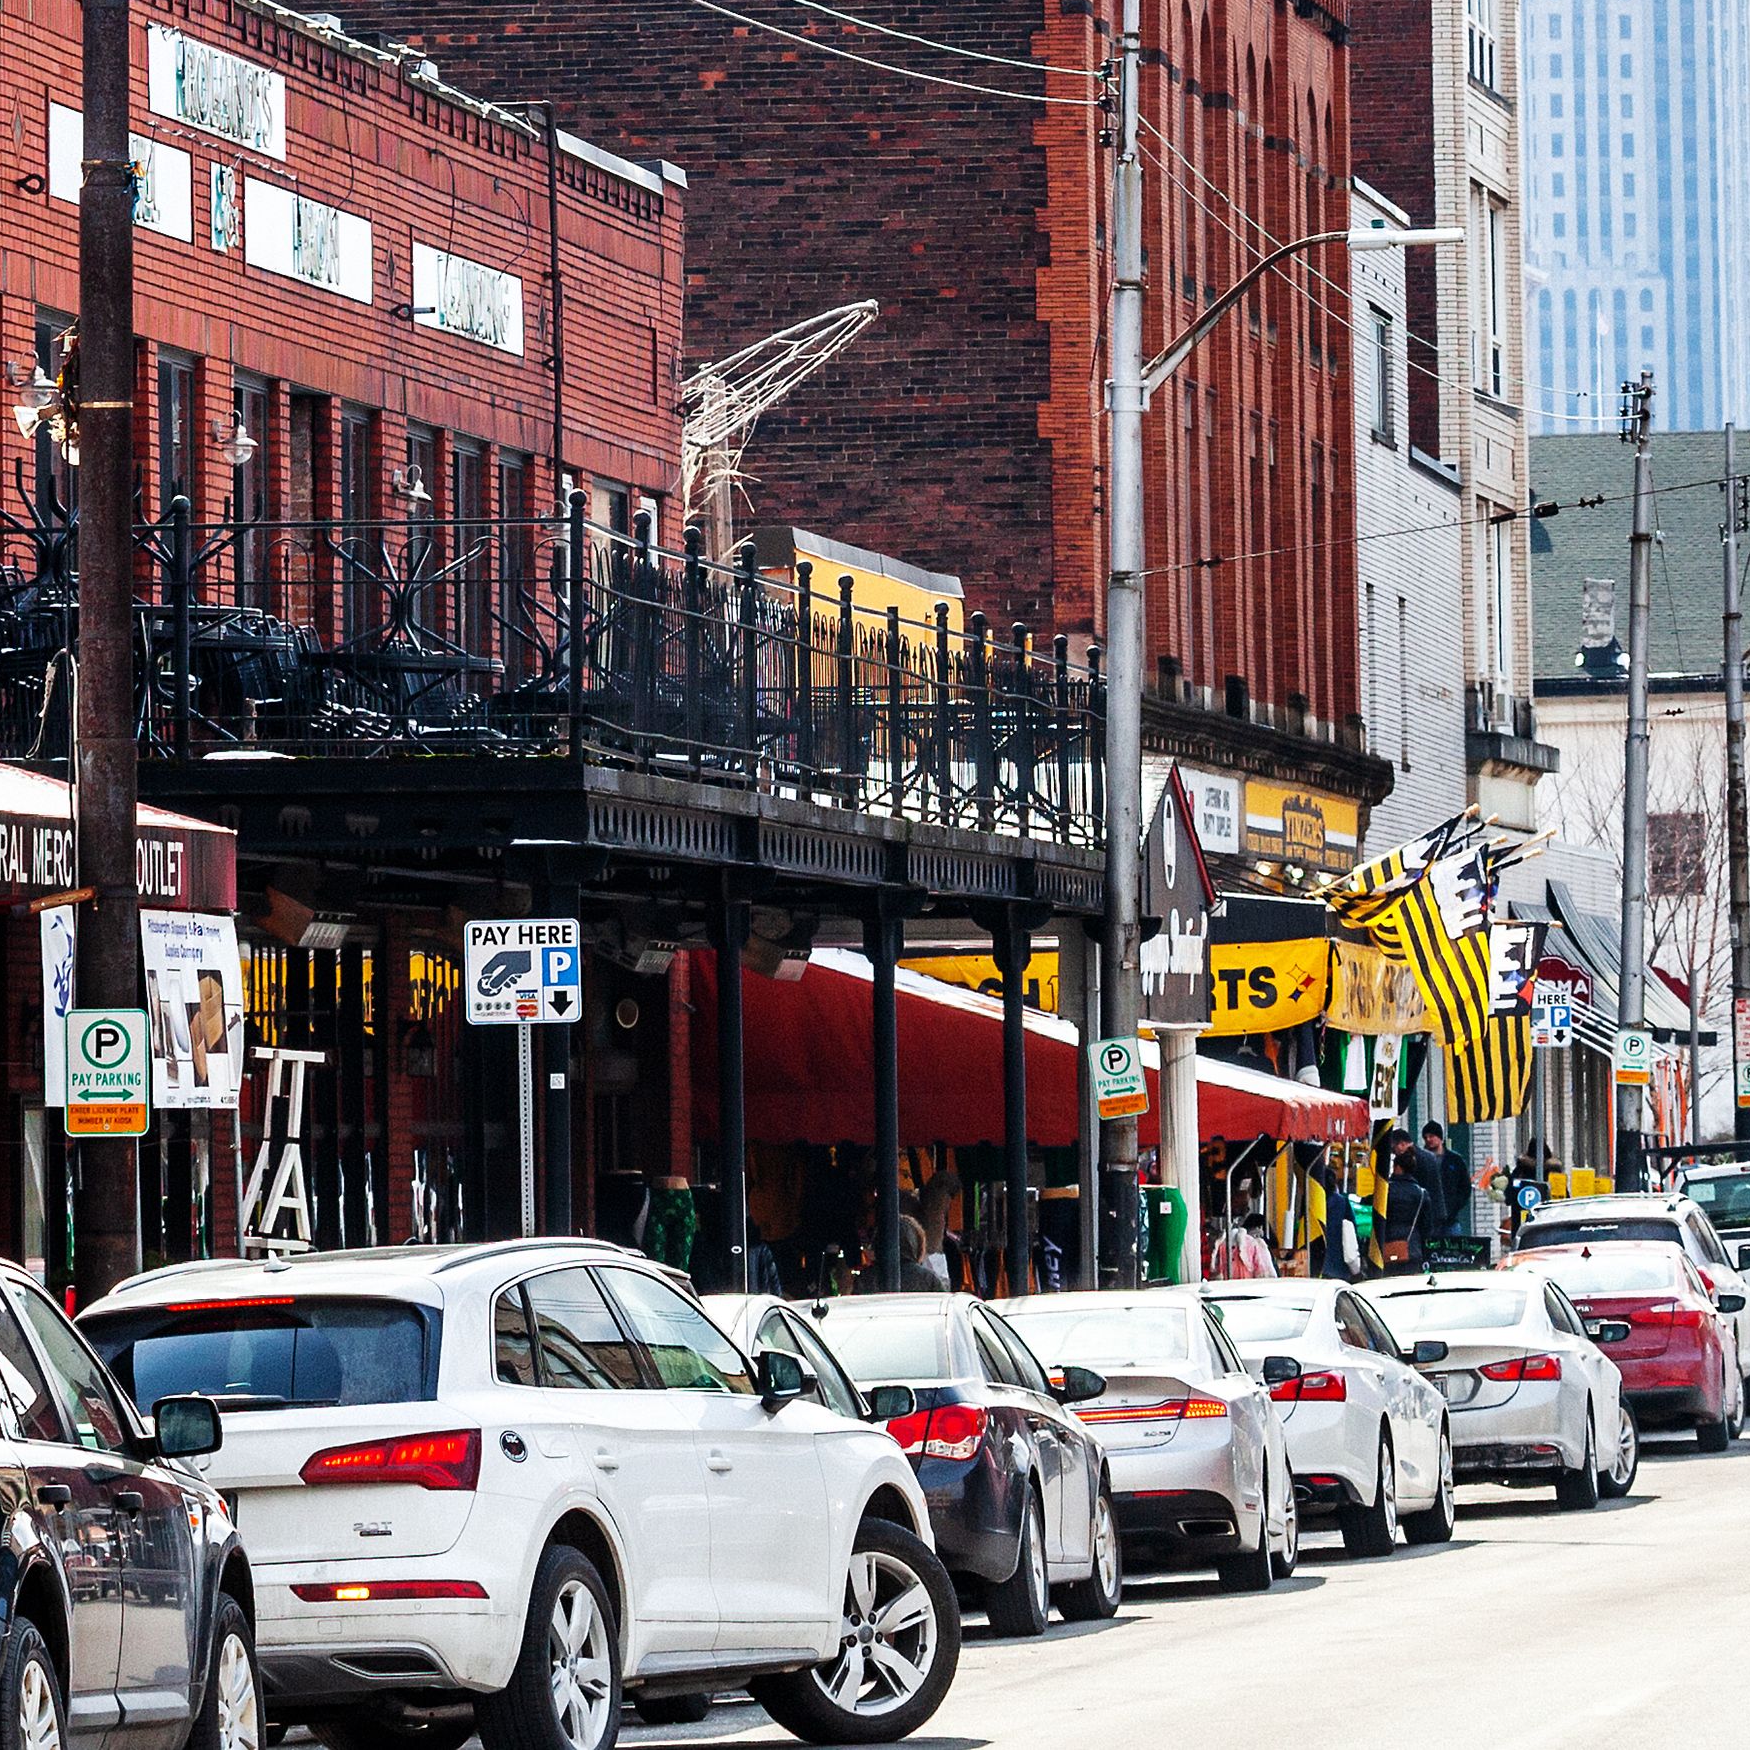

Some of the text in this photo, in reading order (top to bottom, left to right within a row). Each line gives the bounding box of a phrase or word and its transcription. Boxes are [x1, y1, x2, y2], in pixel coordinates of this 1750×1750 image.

[135, 838, 184, 896] OUTLET
[471, 925, 572, 946] PAY HERE
[1537, 993, 1568, 1005] HERE
[72, 1072, 142, 1087] PAY PARKING
[1097, 1075, 1141, 1088] PAY PARKING
